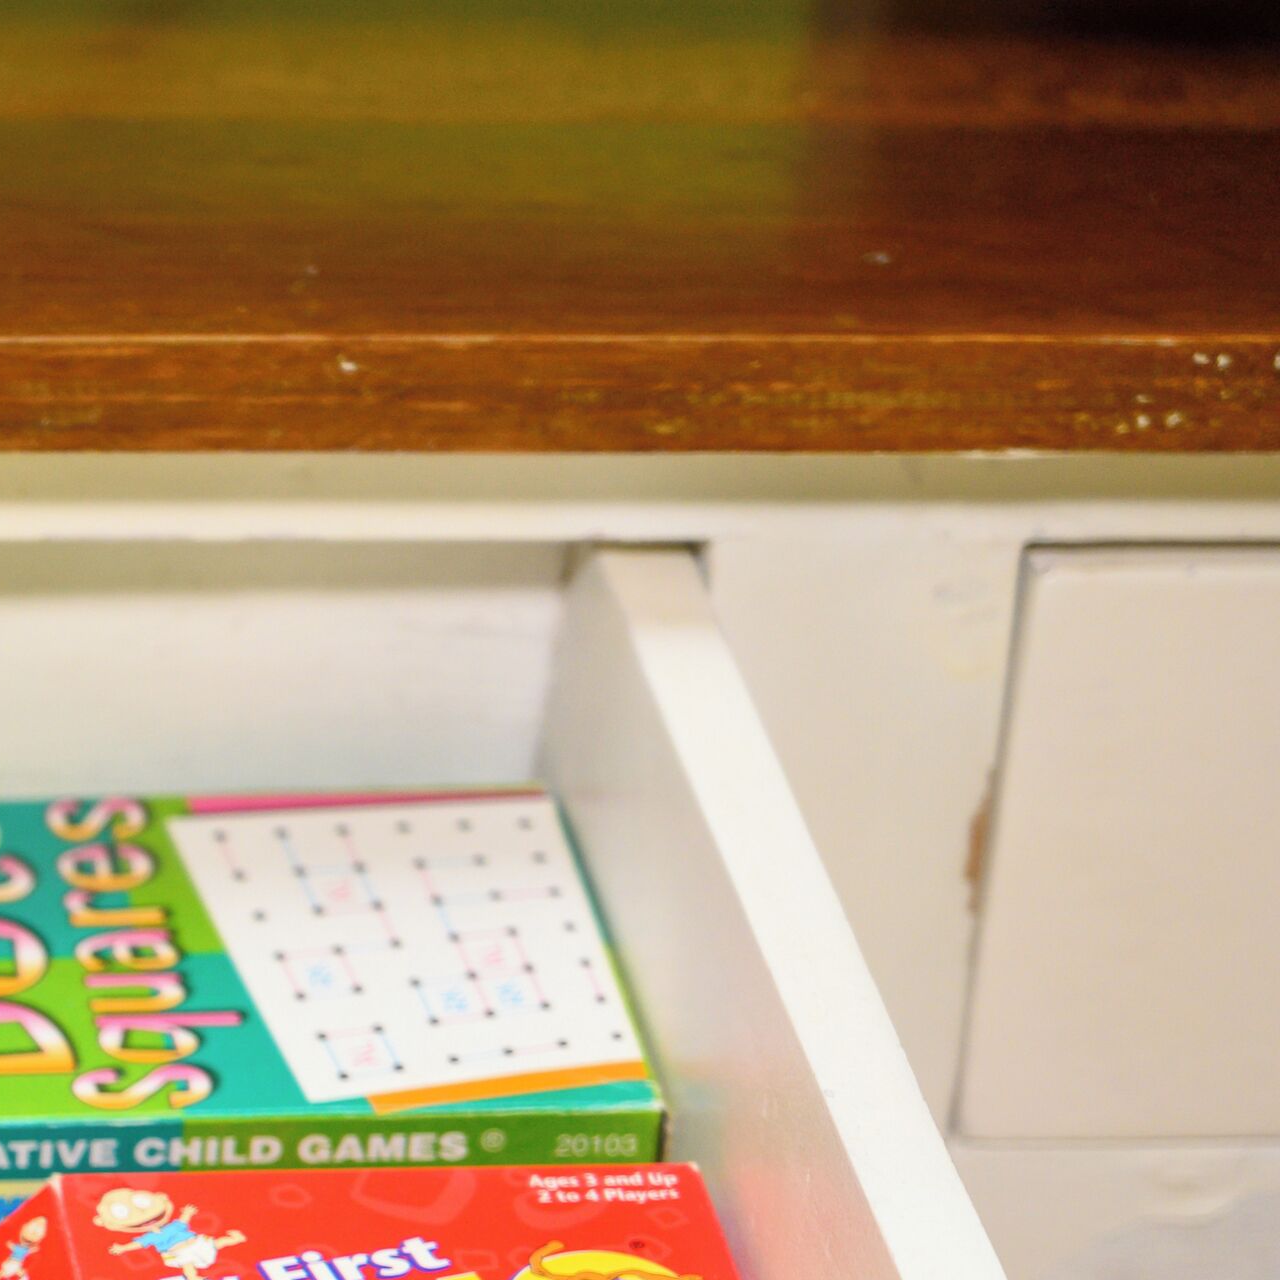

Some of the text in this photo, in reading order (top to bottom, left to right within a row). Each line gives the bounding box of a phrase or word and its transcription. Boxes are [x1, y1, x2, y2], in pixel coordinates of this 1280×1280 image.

[132, 1133, 283, 1168] CHILD
[297, 1130, 470, 1164] GAMES
[555, 1133, 638, 1157] 20103
[529, 1173, 580, 1191] Ages
[603, 1172, 643, 1187] and
[648, 1171, 678, 1188] Up
[556, 1190, 580, 1203] to
[585, 1188, 599, 1202] 4
[603, 1186, 679, 1204] Players
